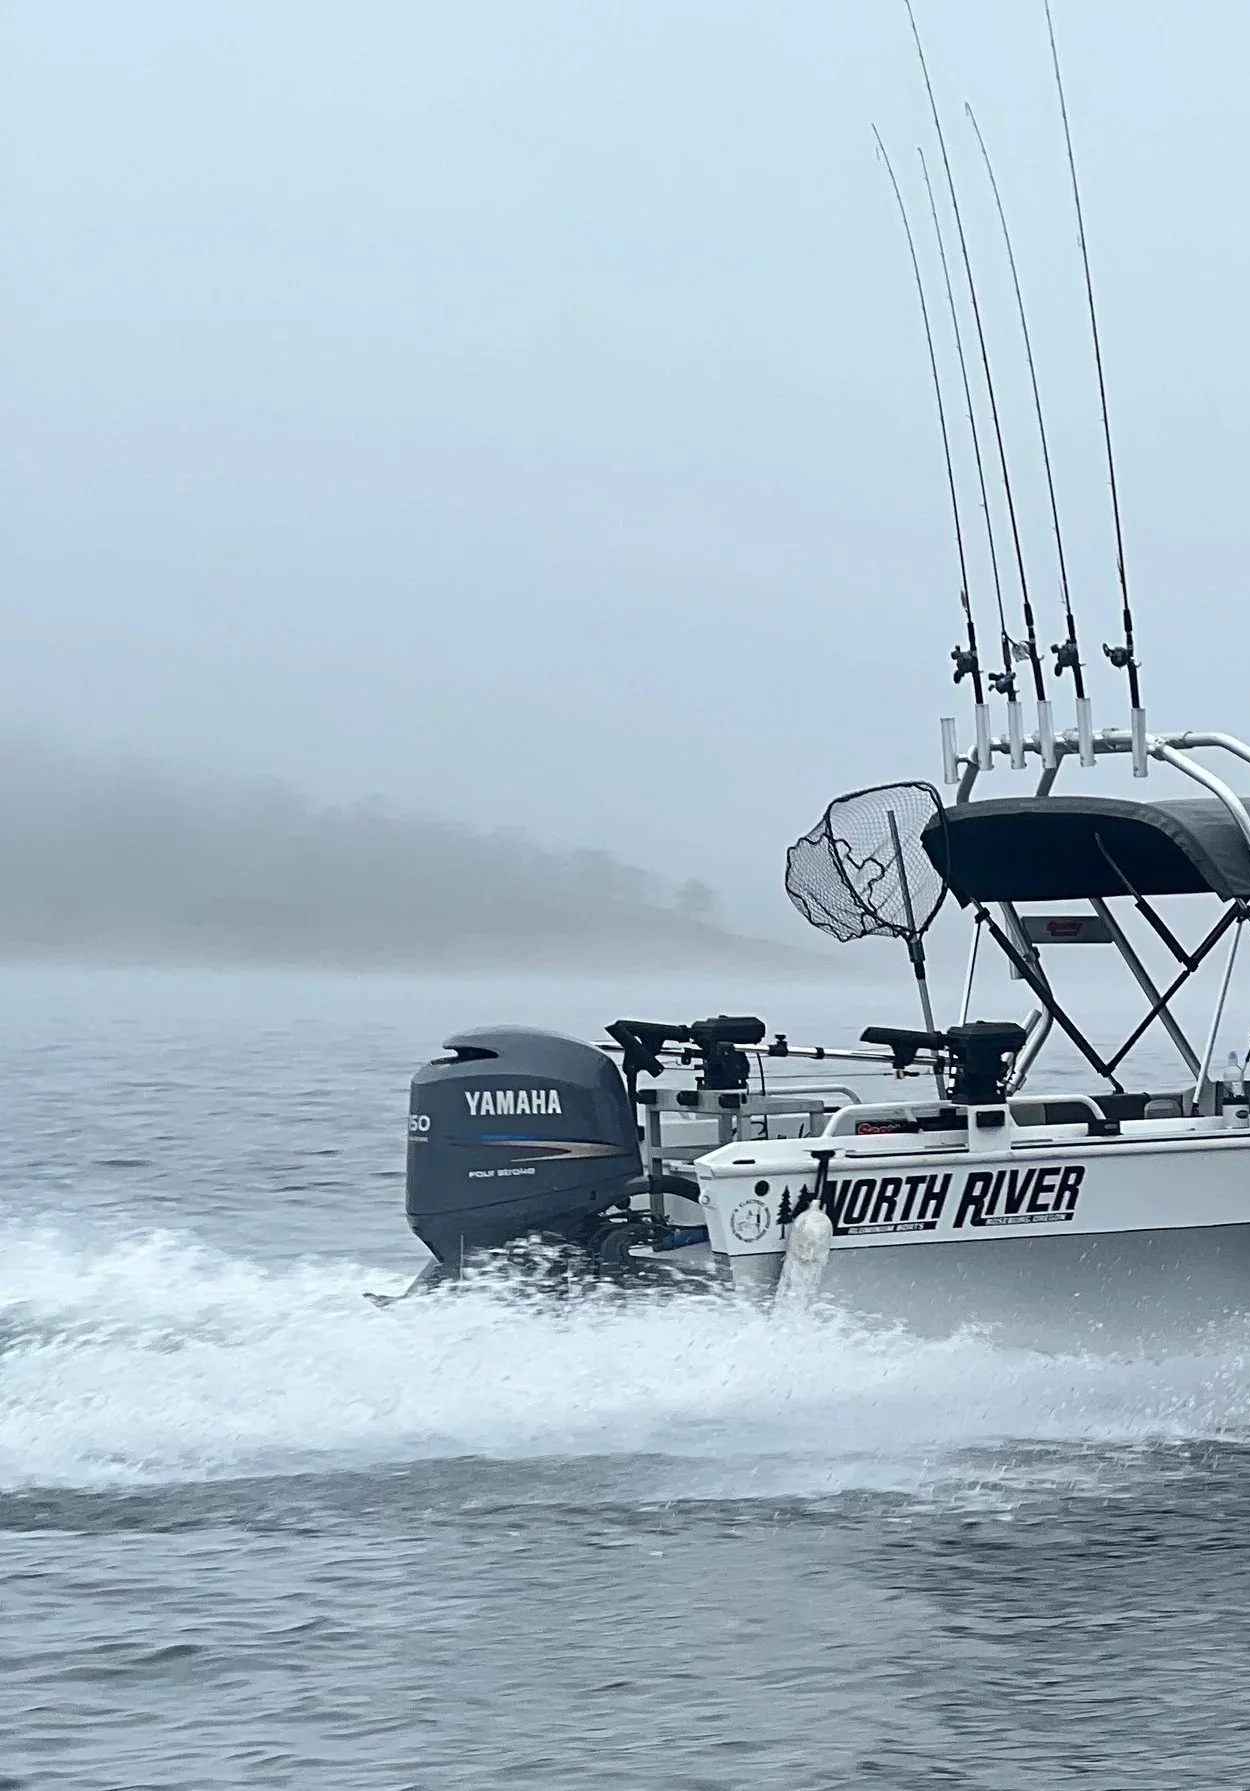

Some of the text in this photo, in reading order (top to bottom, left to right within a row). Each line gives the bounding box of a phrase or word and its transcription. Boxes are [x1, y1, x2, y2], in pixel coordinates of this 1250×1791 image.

[464, 1089, 562, 1116] YAMAHA
[819, 1173, 953, 1231] NORTH
[953, 1165, 1085, 1228] RIVER
